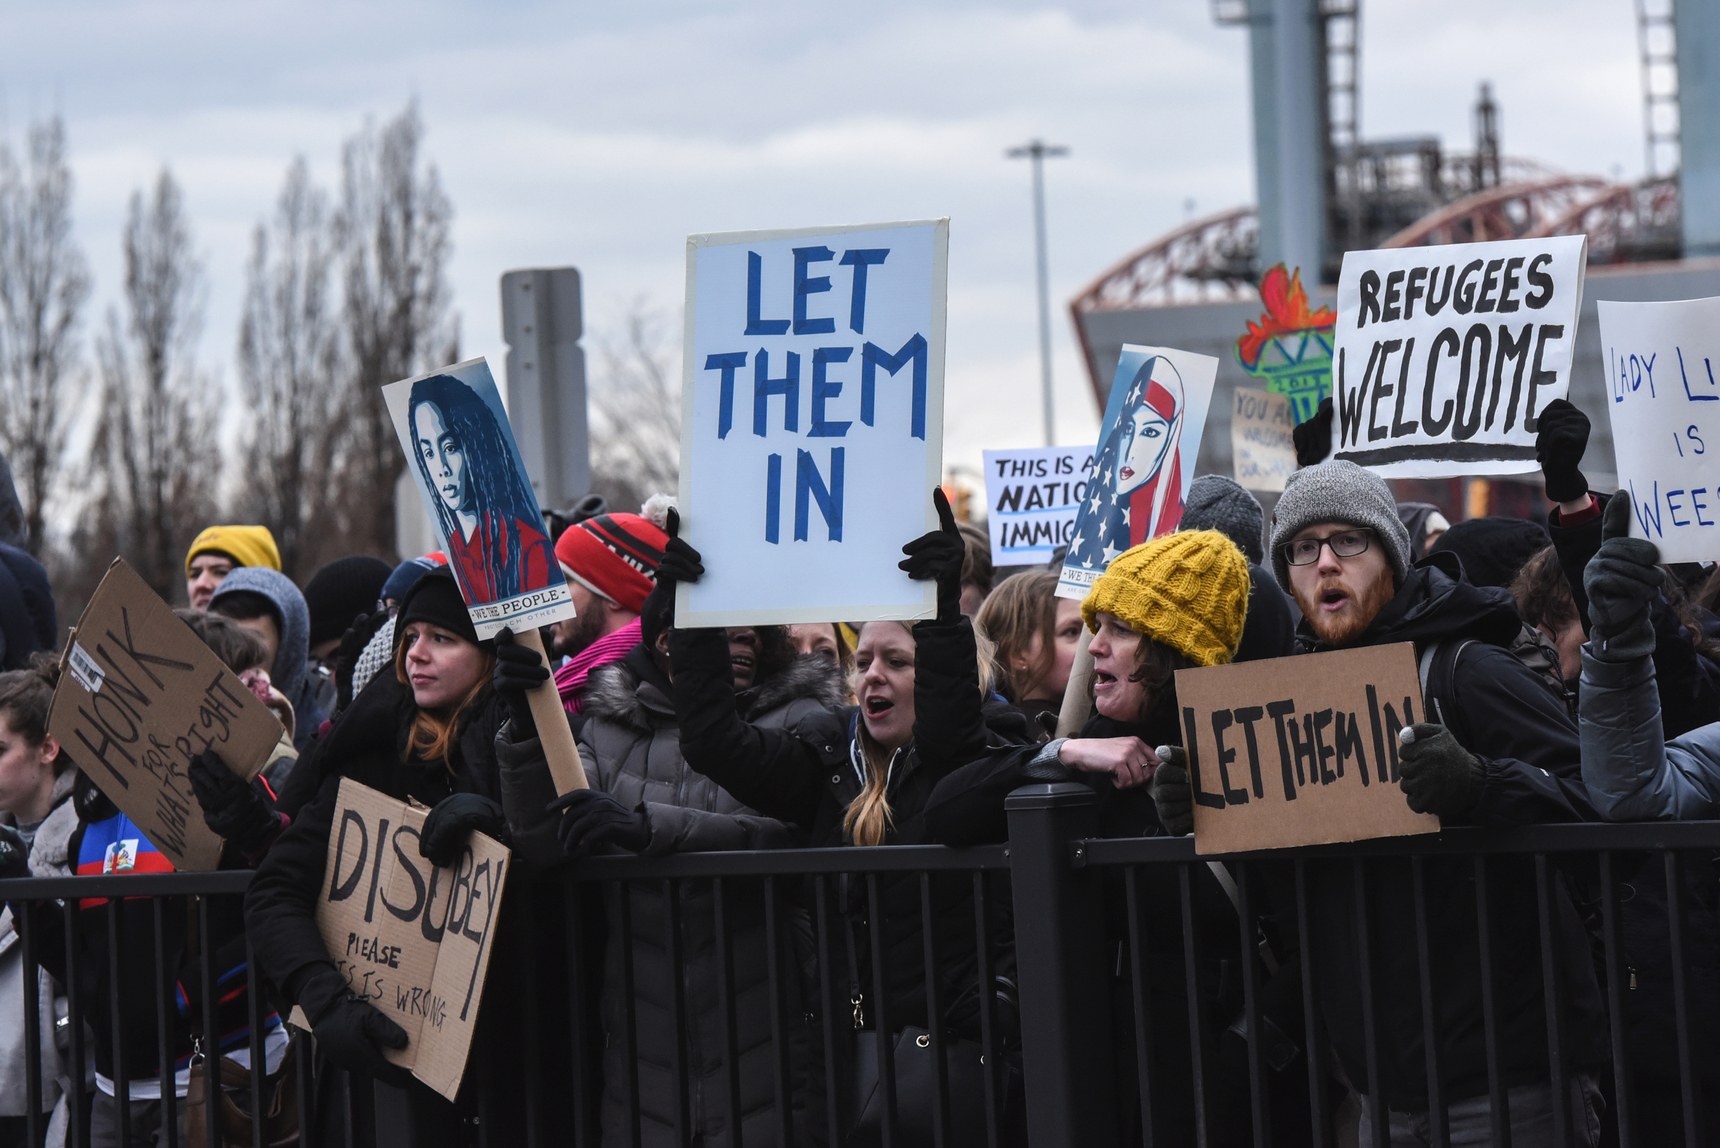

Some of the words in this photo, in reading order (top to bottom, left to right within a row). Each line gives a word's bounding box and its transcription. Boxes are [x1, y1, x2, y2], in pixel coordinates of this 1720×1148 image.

[744, 245, 890, 335] LET
[1357, 253, 1554, 328] REFUGEES
[704, 332, 927, 441] THEM
[1339, 323, 1565, 449] WELCOME
[1611, 347, 1656, 402] LADY
[1237, 393, 1268, 420] YOU
[995, 458, 1048, 478] THIS
[1055, 455, 1074, 475] IS
[1081, 454, 1094, 473] A
[1674, 424, 1705, 457] IS
[765, 446, 845, 545] IN
[474, 607, 488, 620] WE
[486, 606, 500, 617] THE
[501, 589, 560, 615] PEOPLE
[1068, 570, 1082, 582] WE
[527, 608, 557, 621] OTHER
[73, 606, 194, 790] HONK
[142, 733, 170, 780] FOR
[1183, 706, 1264, 810] LET
[1266, 698, 1370, 801] THEM
[1365, 684, 1415, 785] IN
[359, 970, 384, 999] IS
[396, 985, 447, 1032] WRONG
